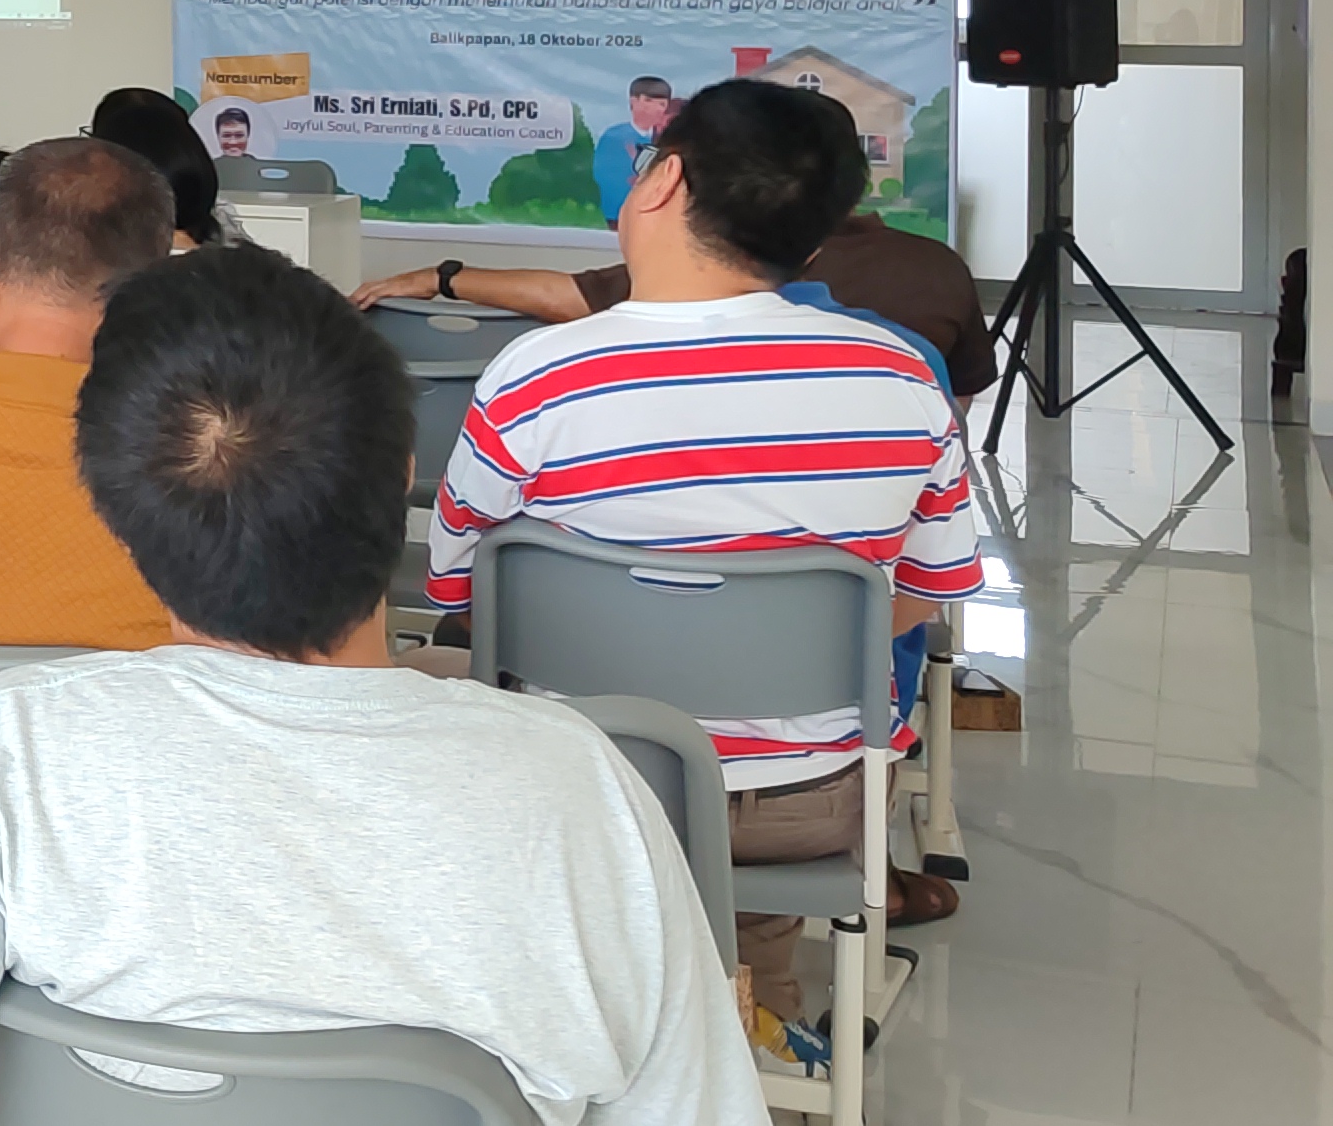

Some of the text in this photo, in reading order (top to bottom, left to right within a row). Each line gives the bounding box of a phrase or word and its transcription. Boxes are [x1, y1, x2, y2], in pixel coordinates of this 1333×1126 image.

[431, 33, 515, 47] Balikpapan,
[519, 34, 536, 45] 18
[540, 33, 601, 46] Oktober
[206, 72, 298, 86] Narasumber
[313, 96, 538, 120] Ms. Sri Erniati, S.Pd, CPC
[284, 118, 563, 140] Joyful Soul, Parenting & Education Coach
